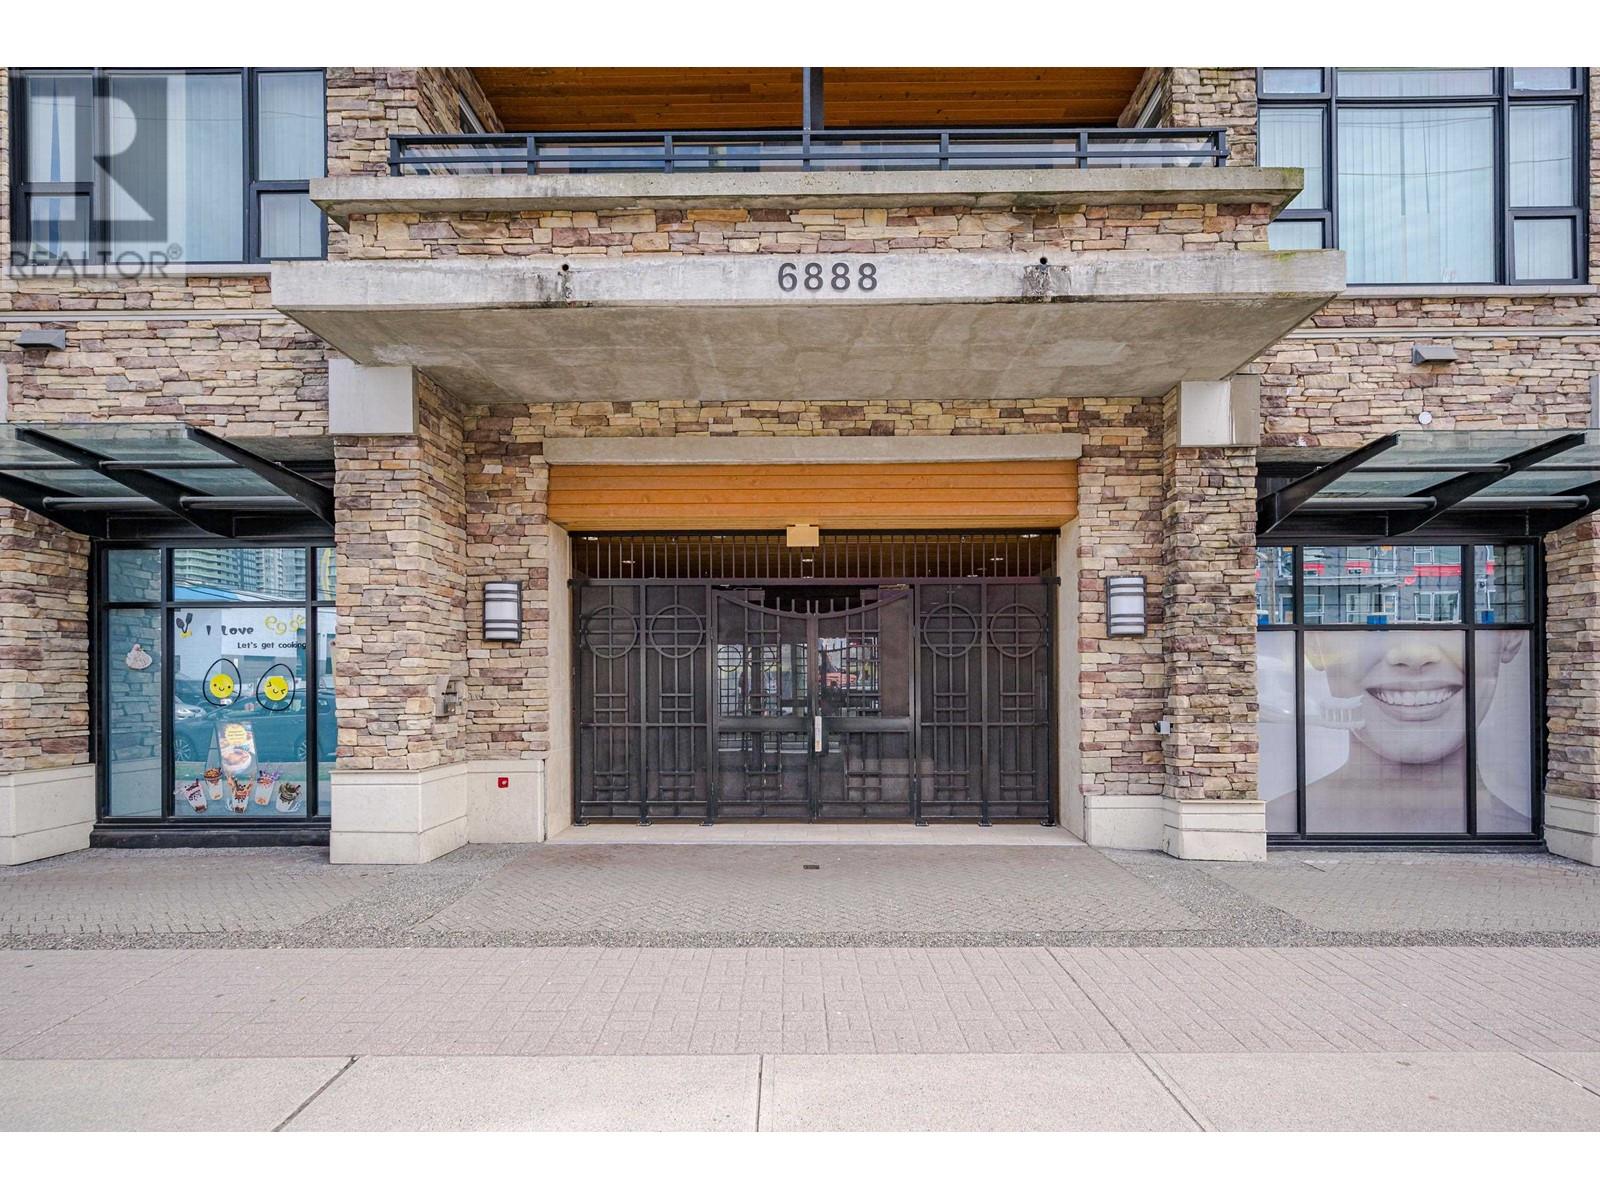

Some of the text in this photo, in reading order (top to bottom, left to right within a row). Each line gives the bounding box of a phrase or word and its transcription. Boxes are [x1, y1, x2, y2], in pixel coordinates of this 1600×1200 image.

[777, 262, 878, 292] 6888
[221, 625, 254, 636] Love
[237, 641, 307, 650] Let's get cooking
